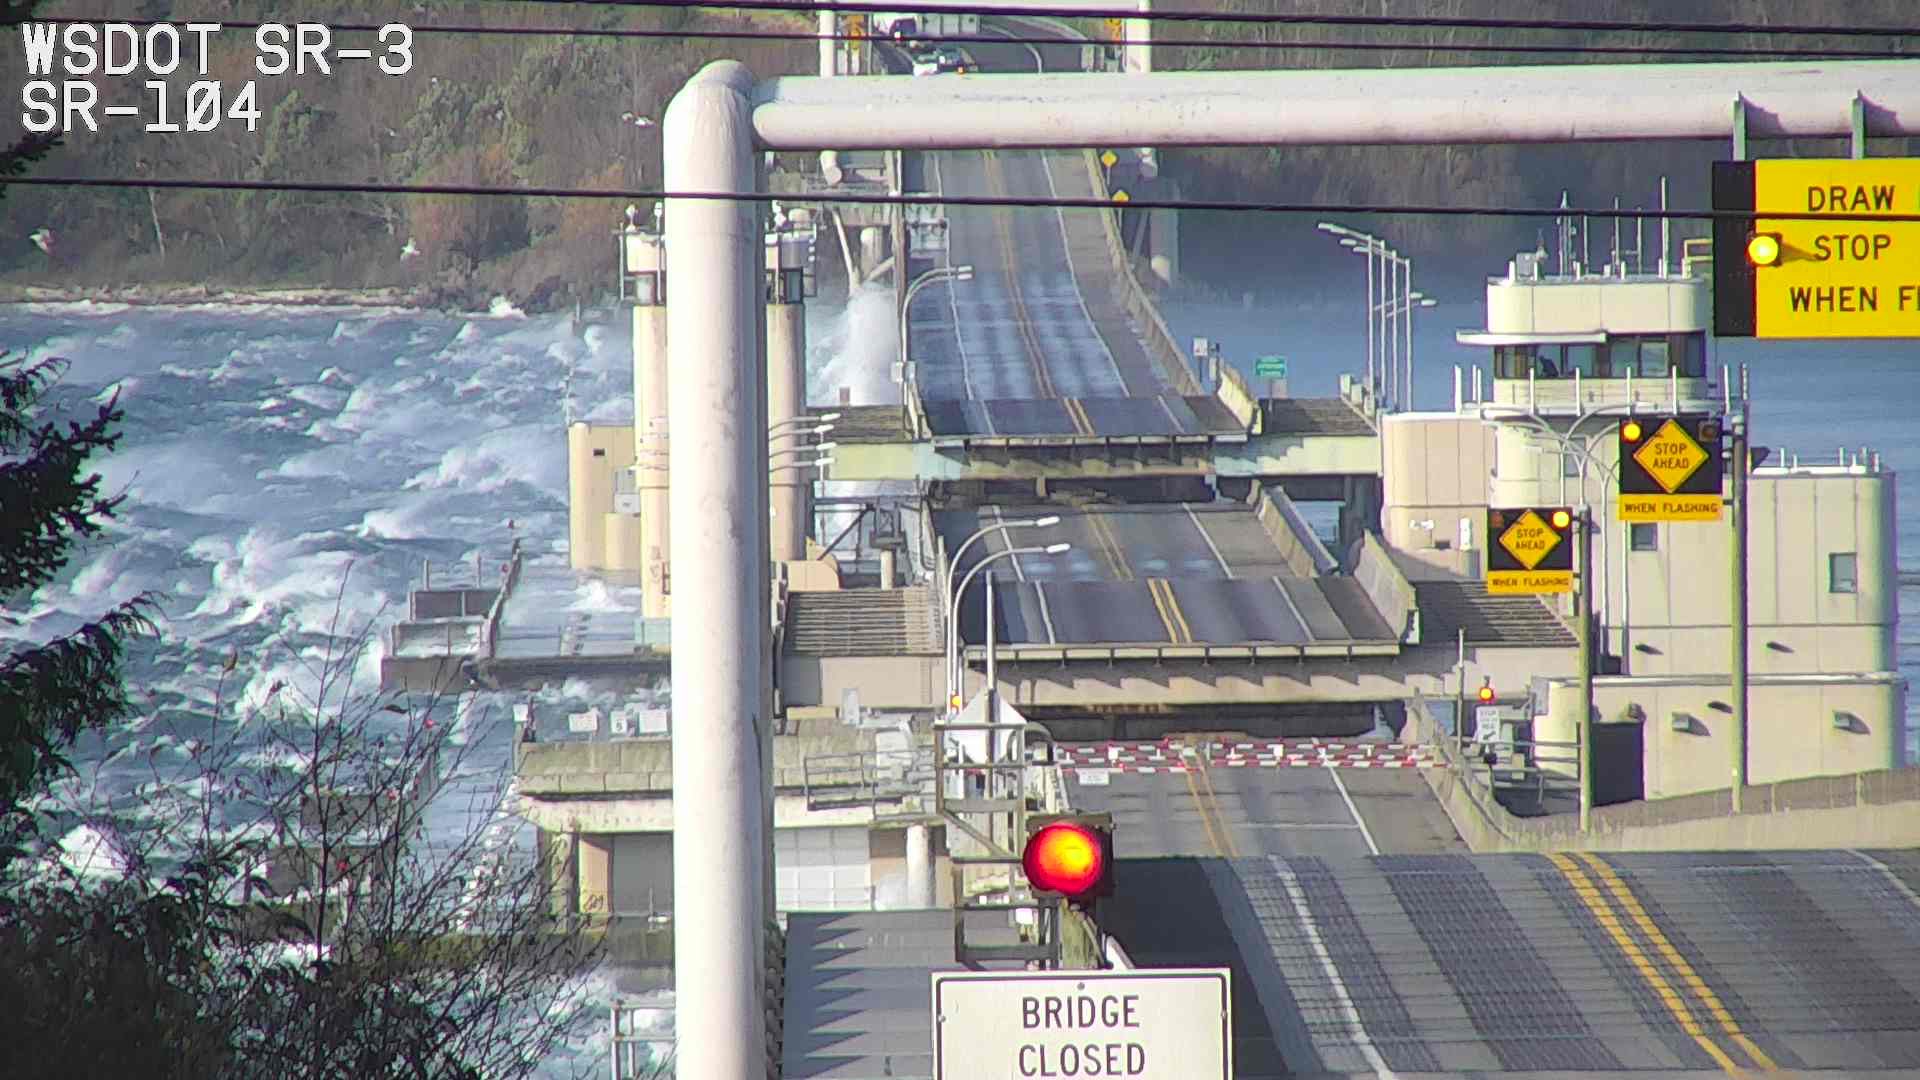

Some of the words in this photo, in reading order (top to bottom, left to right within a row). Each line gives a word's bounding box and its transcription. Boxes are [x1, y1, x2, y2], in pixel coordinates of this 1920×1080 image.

[1807, 185, 1895, 211] DRAW
[1814, 234, 1891, 261] STOP
[1790, 286, 1877, 312] WHEN
[1655, 443, 1687, 455] STOP
[1653, 458, 1688, 468] AHEAD
[1625, 503, 1656, 512] WHEN
[1664, 503, 1718, 512] FLASHING
[1517, 528, 1544, 538] STOP
[1516, 541, 1545, 550] AHEAD
[1493, 578, 1517, 586] WHEN
[1022, 995, 1140, 1029] BRIDGE
[1018, 1043, 1146, 1077] CLOSED
